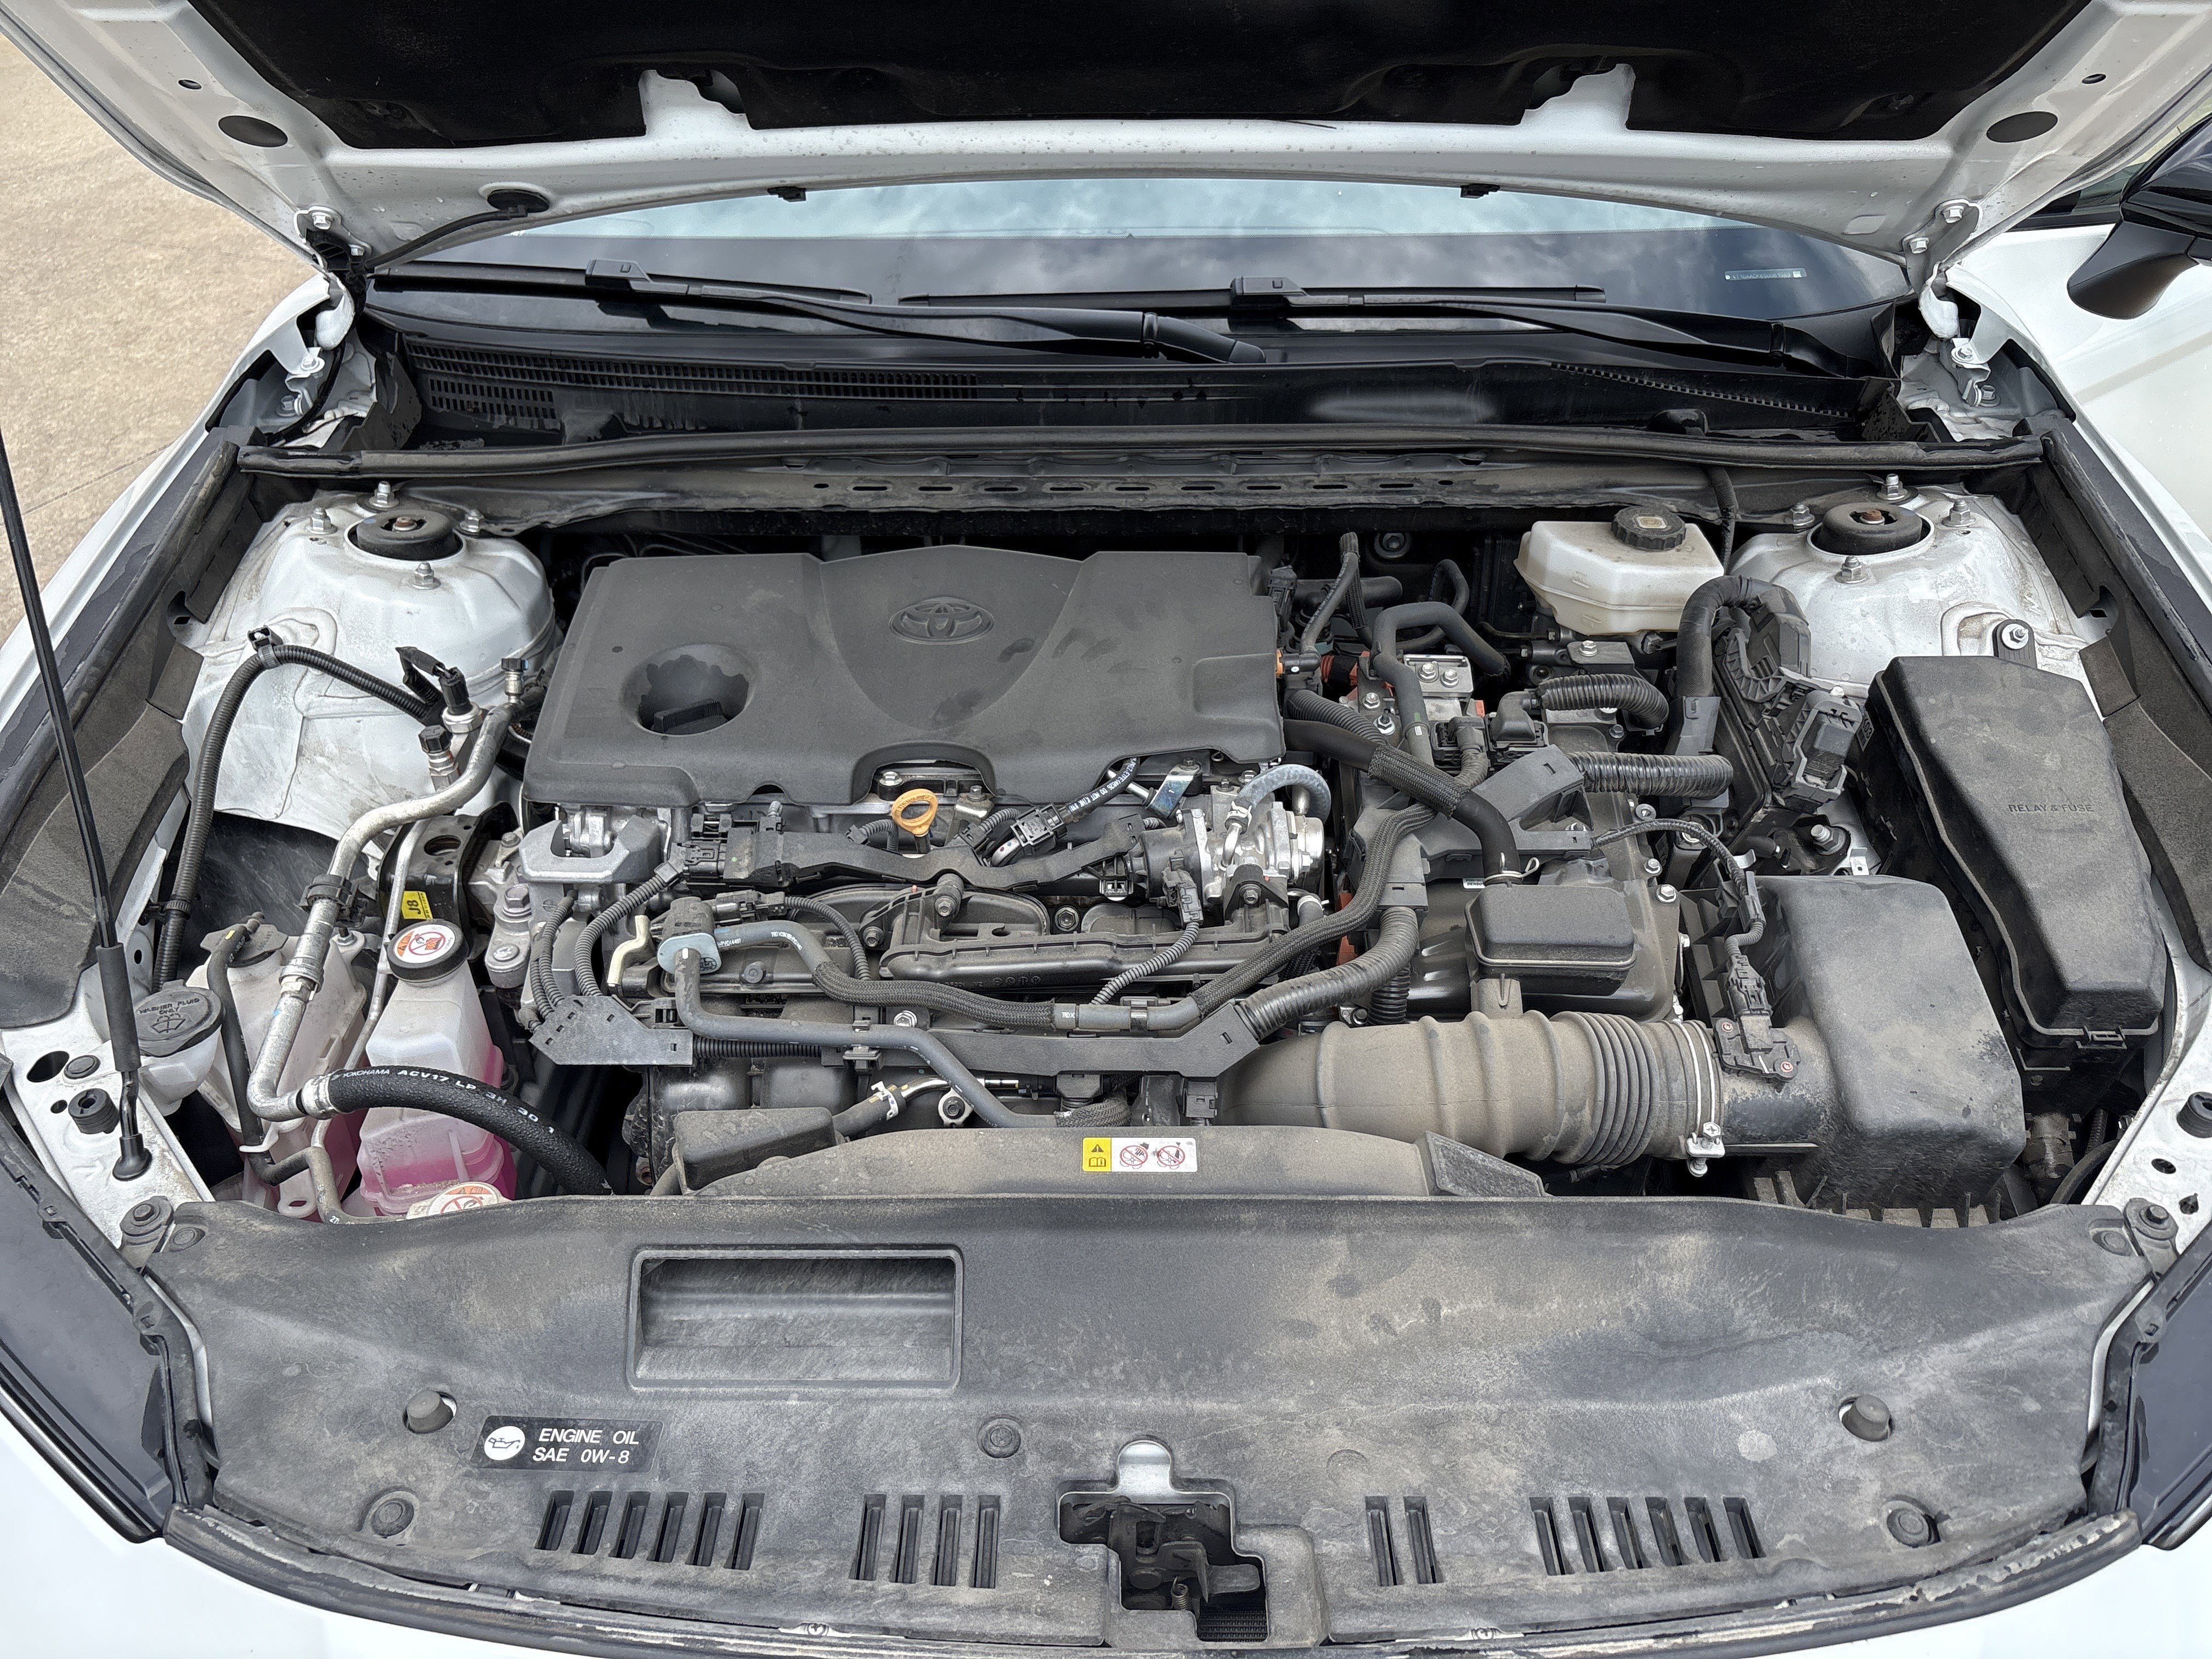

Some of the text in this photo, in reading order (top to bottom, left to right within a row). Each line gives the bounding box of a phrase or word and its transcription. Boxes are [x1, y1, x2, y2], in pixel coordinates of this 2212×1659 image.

[159, 1007, 179, 1015] ONLY
[177, 998, 200, 1007] FLUID
[342, 1069, 390, 1079] YOKOHAMA
[398, 1070, 449, 1082] ACV17
[455, 1080, 476, 1090] LP
[538, 1427, 639, 1444] ENGINE OIL
[532, 1447, 630, 1464] SAE 0W-8
